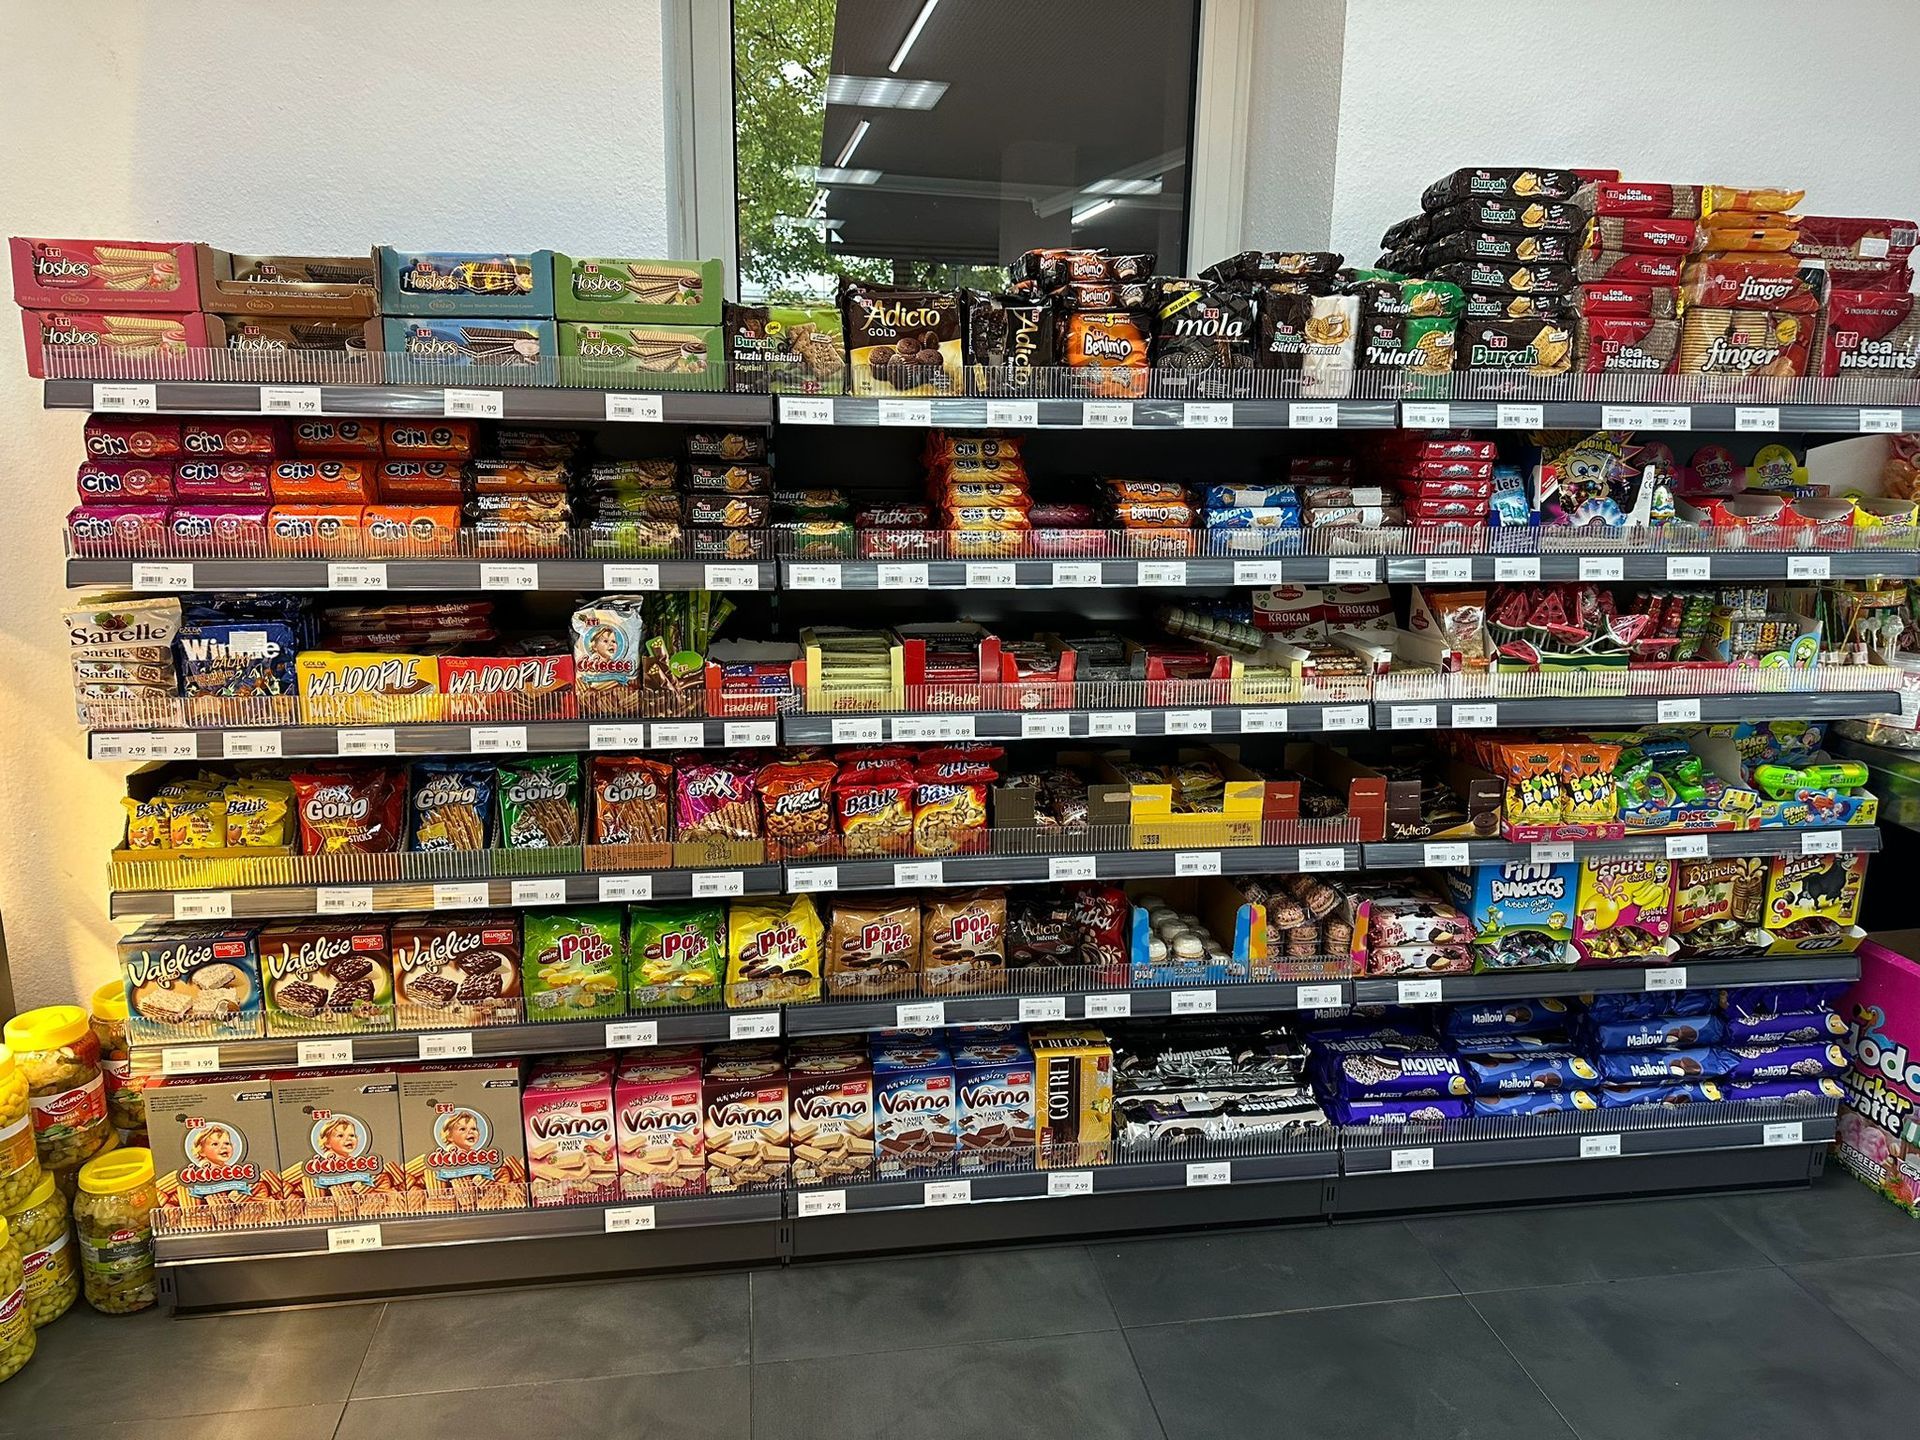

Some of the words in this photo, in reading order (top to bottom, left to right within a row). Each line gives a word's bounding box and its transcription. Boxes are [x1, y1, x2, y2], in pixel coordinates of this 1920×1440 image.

[1738, 276, 1794, 300] finger
[1175, 313, 1243, 337] mola
[868, 327, 897, 338] GOLD
[1859, 338, 1893, 355] tea
[733, 351, 761, 361] Tuzlu
[1471, 346, 1539, 367] Burçak
[1620, 346, 1643, 358] tea
[1702, 338, 1779, 371] finger
[1605, 355, 1660, 369] biscuits
[1839, 351, 1917, 369] biscuits
[132, 398, 150, 407] 1.99
[480, 404, 497, 413] 1.99
[909, 413, 926, 422] 2.99
[1112, 415, 1128, 424] 3.99
[1430, 416, 1446, 424] 3.99
[1884, 421, 1899, 429] 3.99
[1481, 445, 1489, 455] 4
[1479, 465, 1488, 475] 4
[1478, 484, 1488, 495] 4
[1476, 503, 1484, 513] 4
[1166, 573, 1182, 581] 1.29
[1453, 569, 1468, 578] 1.29
[1605, 569, 1620, 577] 1.99
[363, 576, 381, 586] 2.99
[737, 576, 753, 586] 1.49
[996, 575, 1012, 584] 1.29
[1339, 605, 1379, 613] KROKAN
[1269, 613, 1310, 622] KROKAN
[71, 624, 167, 645] Sarelle
[80, 668, 130, 679] Sarelle
[309, 659, 417, 697] WHOOPIE
[449, 659, 559, 694] WHOOPIE
[724, 701, 768, 712] tadelle
[1269, 720, 1283, 728] 1.19
[1418, 716, 1433, 725] 1.39
[861, 729, 877, 738] 0.89
[1050, 724, 1065, 733] 1.19
[683, 734, 699, 743] 1.79
[173, 745, 191, 755] 2.99
[373, 741, 390, 751] 1.19
[510, 783, 568, 803] Gong
[603, 783, 658, 802] Gong
[417, 788, 477, 809] Gong
[776, 788, 820, 814] Pizza
[306, 798, 369, 821] Gong
[1556, 850, 1570, 859] 1.99
[1325, 859, 1340, 867] 0.69
[1784, 858, 1820, 875] BALLS
[923, 873, 938, 882] 1.39
[1688, 864, 1737, 887] Barrels
[723, 883, 739, 892] 1.69
[467, 895, 483, 904] 1.69
[209, 905, 226, 914] 1.19
[1424, 990, 1438, 999] 2.69
[1198, 1001, 1212, 1009] 0.39
[925, 1014, 940, 1022] 2.69
[1315, 1008, 1350, 1020] Mallow
[1472, 1012, 1503, 1024] Mallow
[636, 1032, 652, 1041] 2.69
[1627, 1032, 1663, 1047] Mallow
[1748, 1032, 1784, 1042] Mallow
[197, 1059, 213, 1068] 1.99
[1631, 1063, 1667, 1076] Mallow
[1753, 1066, 1788, 1076] Mallow
[1499, 1076, 1531, 1089] Mallow
[881, 1092, 950, 1114] Varna
[962, 1088, 1030, 1109] Varna
[795, 1098, 867, 1121] Varna
[984, 1110, 1006, 1119] FAMILY
[623, 1108, 697, 1131] Varna
[709, 1105, 782, 1127] Varna
[903, 1115, 925, 1124] FAMILY
[987, 1114, 1004, 1122] PACK
[1369, 1112, 1406, 1125] Mallow
[531, 1116, 608, 1138] Varna
[819, 1122, 844, 1130] FAMILY
[906, 1119, 924, 1127] PACK
[648, 1133, 672, 1141] FAMILY
[734, 1129, 757, 1137] FAMILY
[1416, 1158, 1430, 1167] 1.99
[952, 1192, 967, 1200] 2.99
[635, 1217, 650, 1226] 2.99
